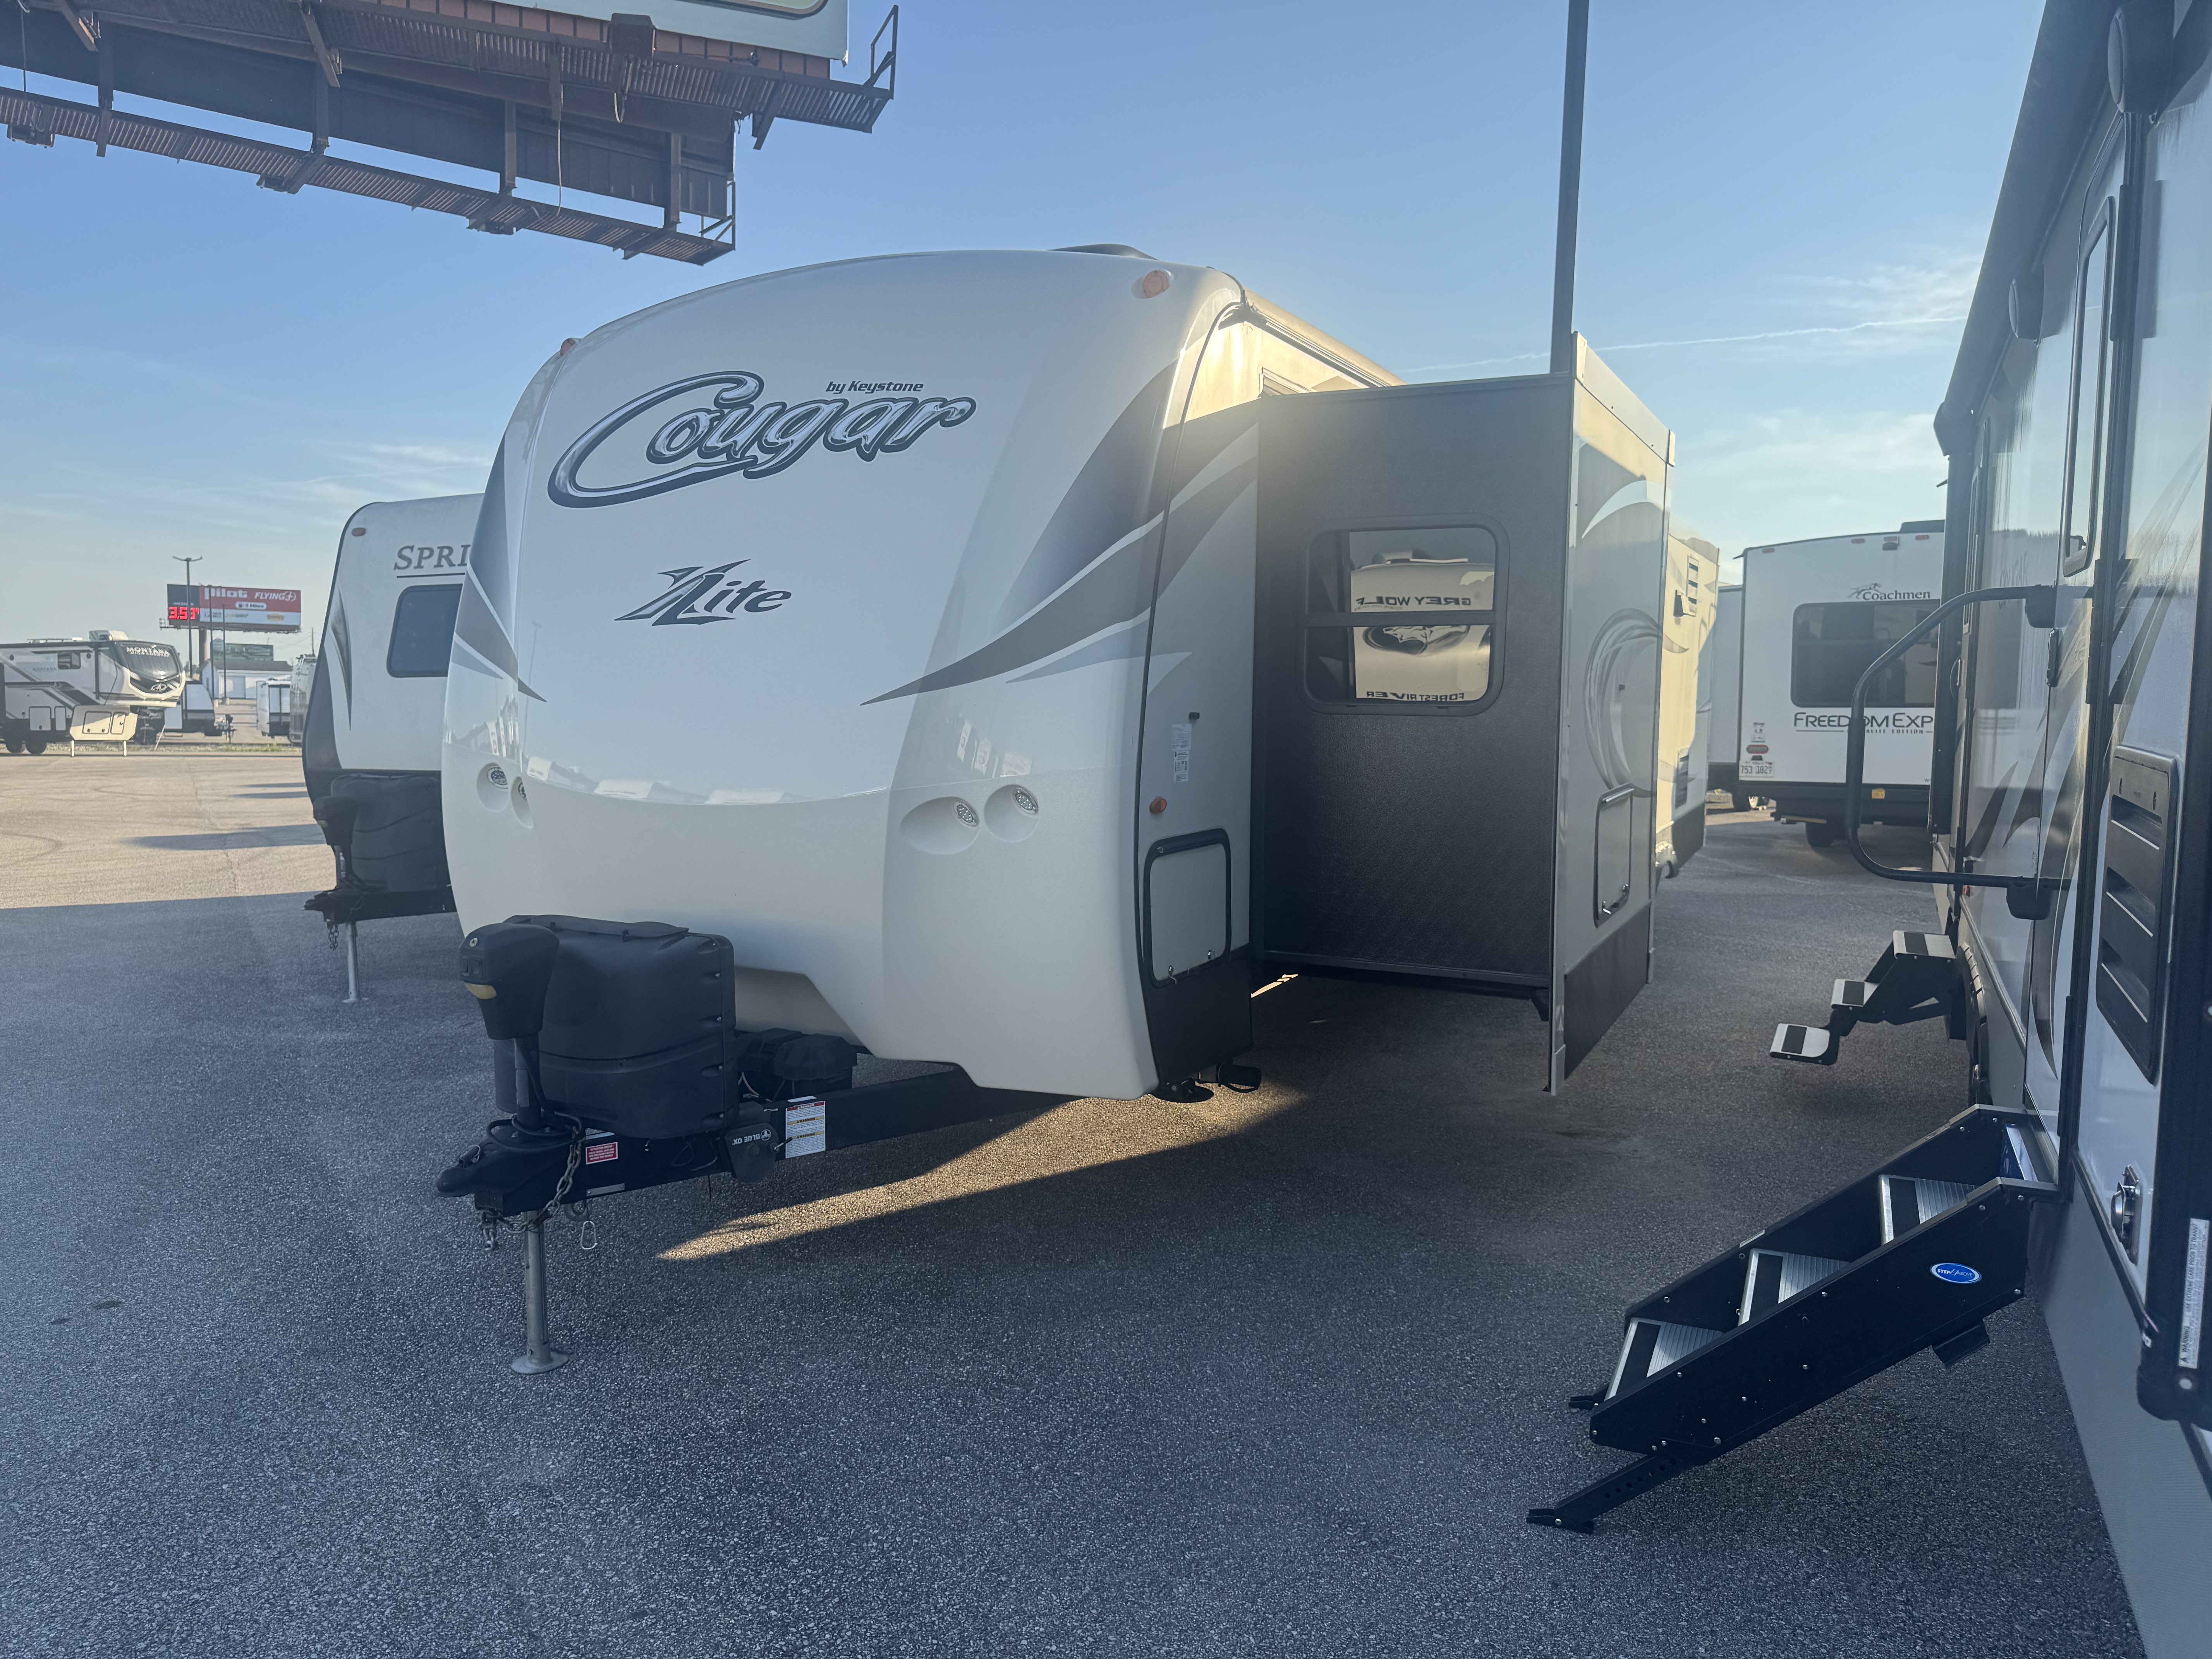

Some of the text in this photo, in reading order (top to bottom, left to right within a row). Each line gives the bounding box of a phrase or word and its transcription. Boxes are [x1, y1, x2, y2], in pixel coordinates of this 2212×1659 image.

[825, 381, 924, 394] by Keystone
[548, 371, 977, 508] Cougar
[393, 544, 471, 570] SPRI
[254, 592, 285, 600] FLYING
[1862, 590, 1930, 600] Coachmen
[744, 1133, 760, 1142] BLUE
